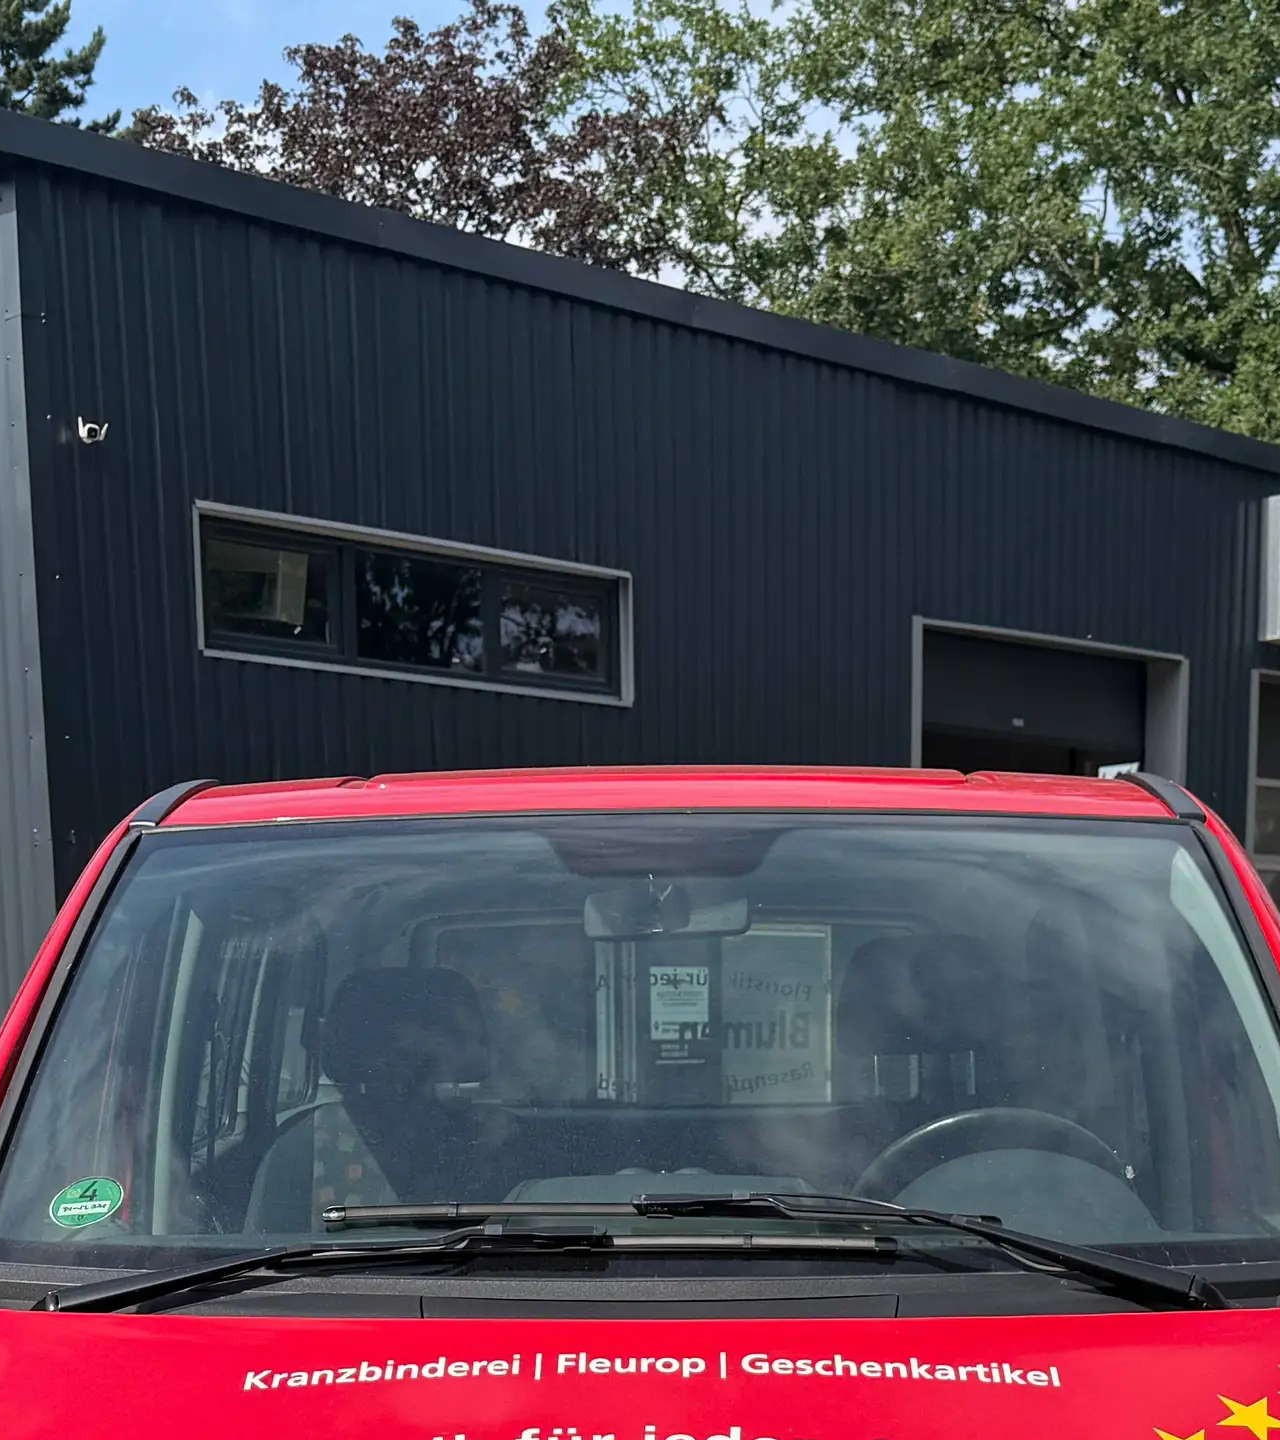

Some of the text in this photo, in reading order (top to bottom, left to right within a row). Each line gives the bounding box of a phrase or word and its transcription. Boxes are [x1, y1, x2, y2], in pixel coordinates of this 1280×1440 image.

[78, 1180, 99, 1202] 4
[243, 1353, 521, 1391] Kranzbinderei
[557, 1352, 706, 1378] Fleurop
[741, 1353, 1061, 1387] Geschenkartikel
